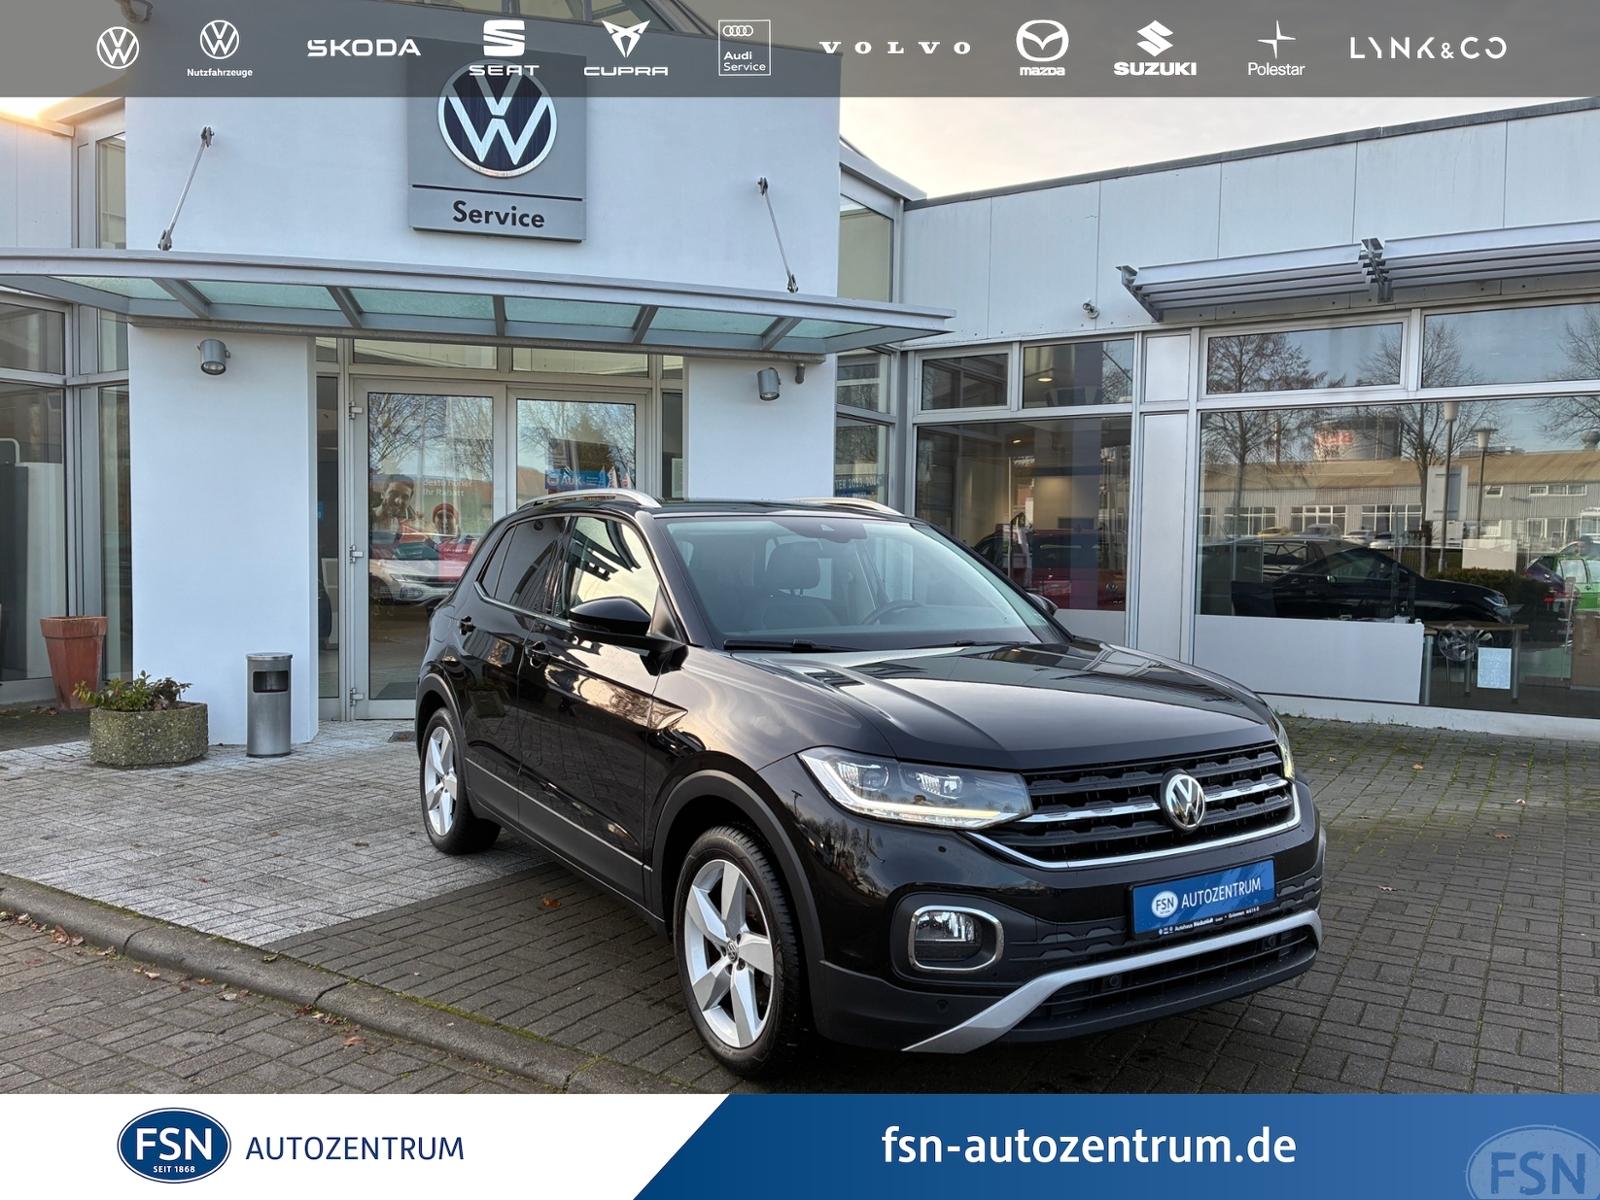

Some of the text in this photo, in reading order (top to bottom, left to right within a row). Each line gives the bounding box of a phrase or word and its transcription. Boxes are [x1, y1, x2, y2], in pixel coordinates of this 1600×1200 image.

[452, 200, 545, 229] Service
[1155, 877, 1262, 911] FSN AUTOZENTRUM
